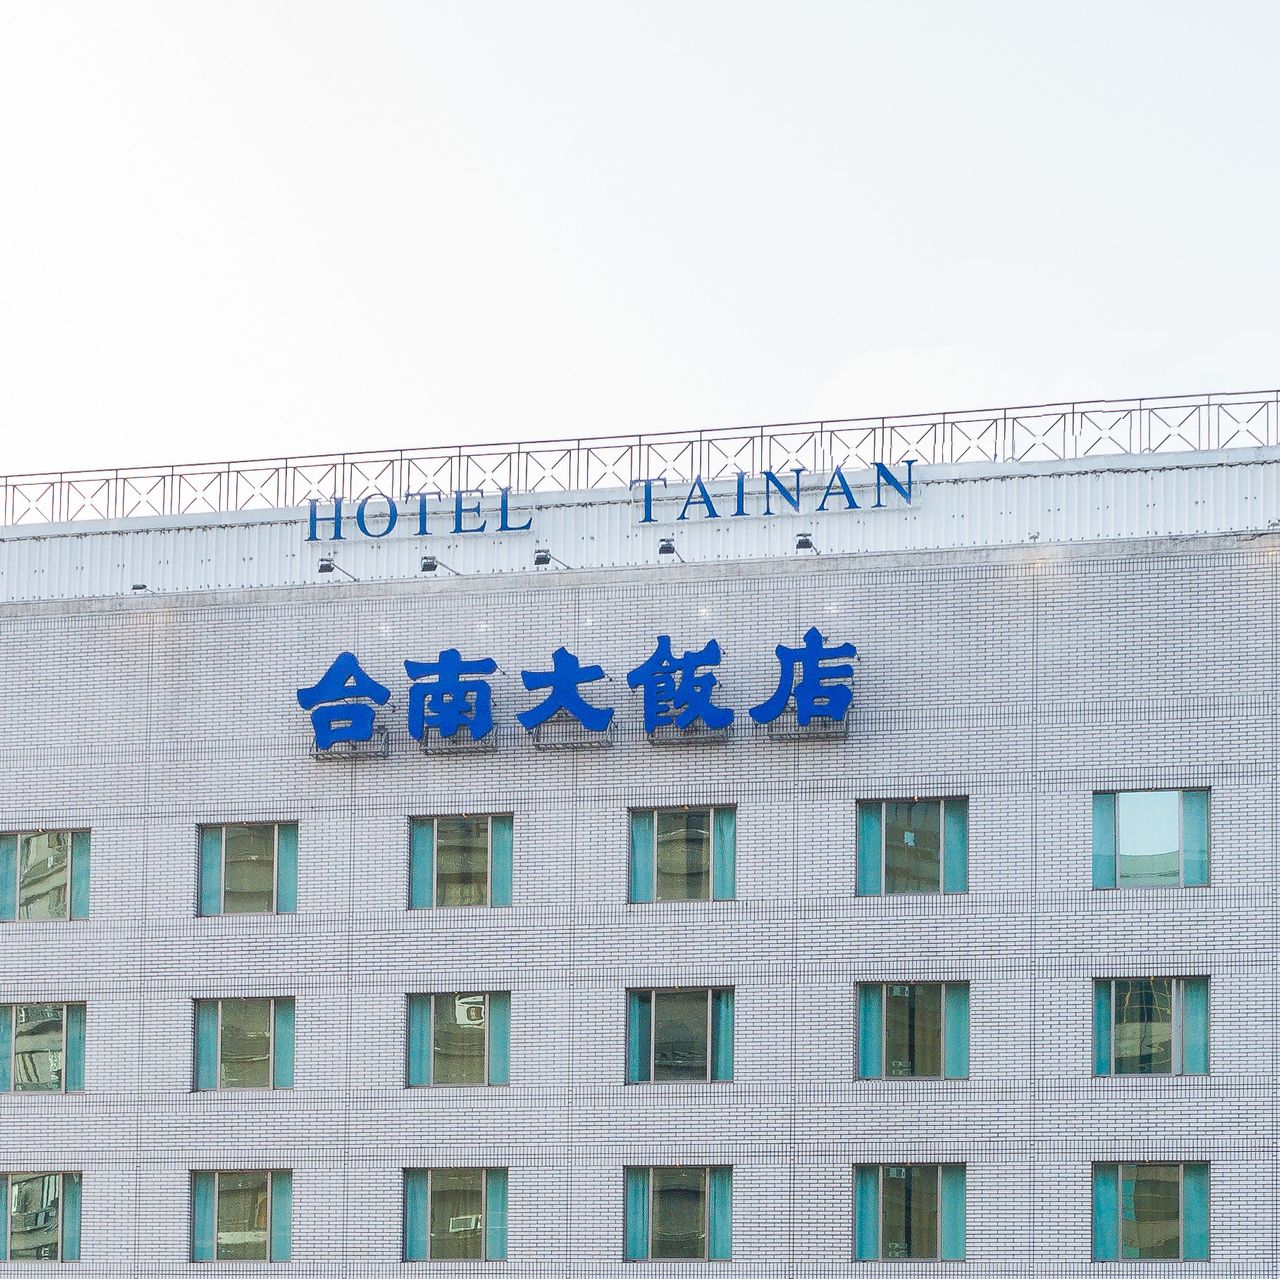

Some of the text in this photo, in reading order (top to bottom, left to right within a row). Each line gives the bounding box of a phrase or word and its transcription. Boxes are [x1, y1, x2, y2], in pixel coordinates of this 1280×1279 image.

[304, 459, 918, 542] HOTEL TAINAN
[296, 627, 858, 751] 台南大飯店
